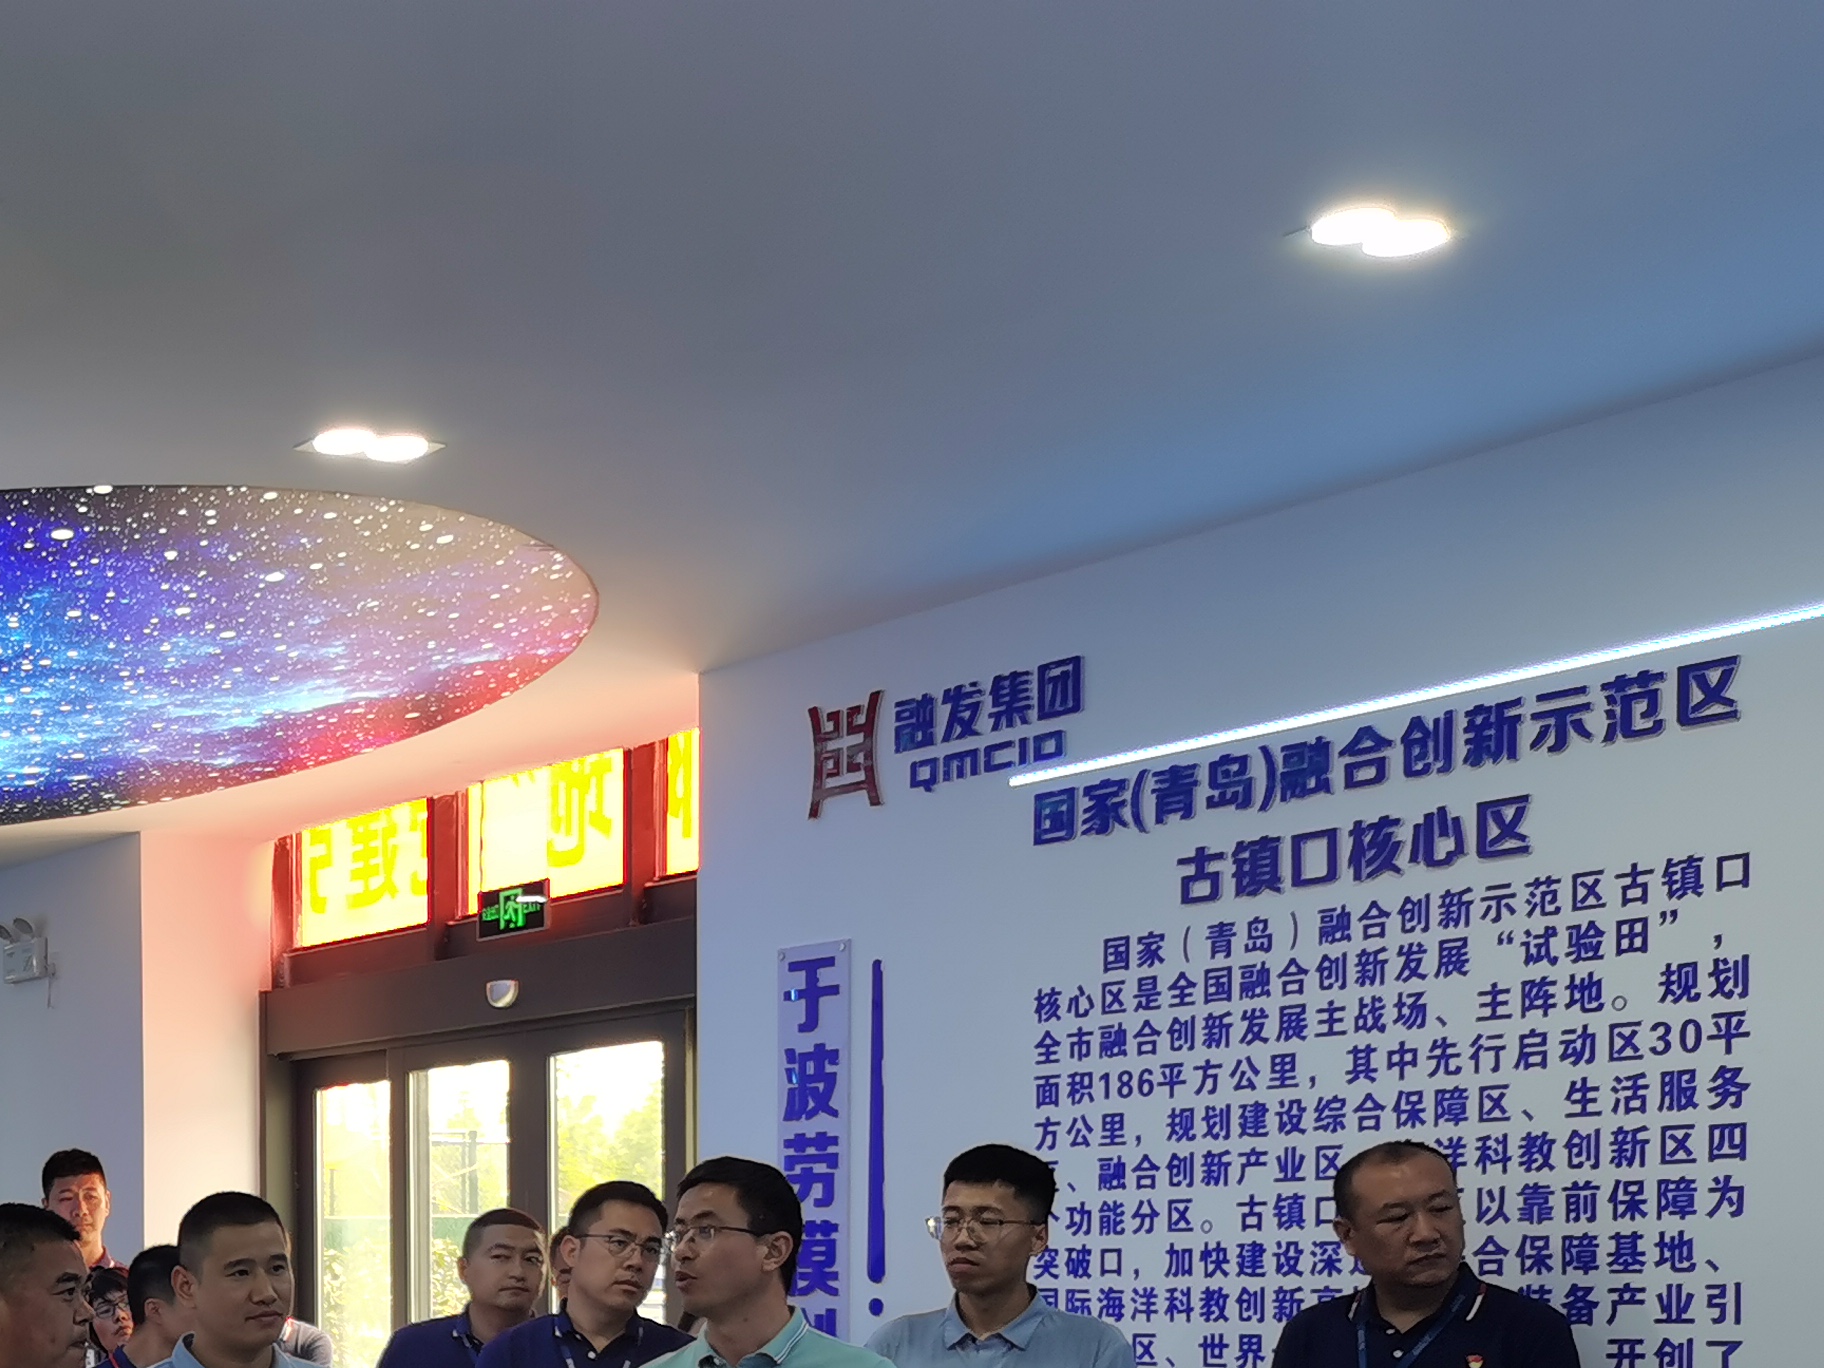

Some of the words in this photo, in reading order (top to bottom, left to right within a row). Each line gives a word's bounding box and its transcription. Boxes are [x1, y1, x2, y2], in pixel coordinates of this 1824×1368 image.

[894, 655, 1083, 754] 融发集团
[1176, 795, 1533, 906] 古镇口核心区
